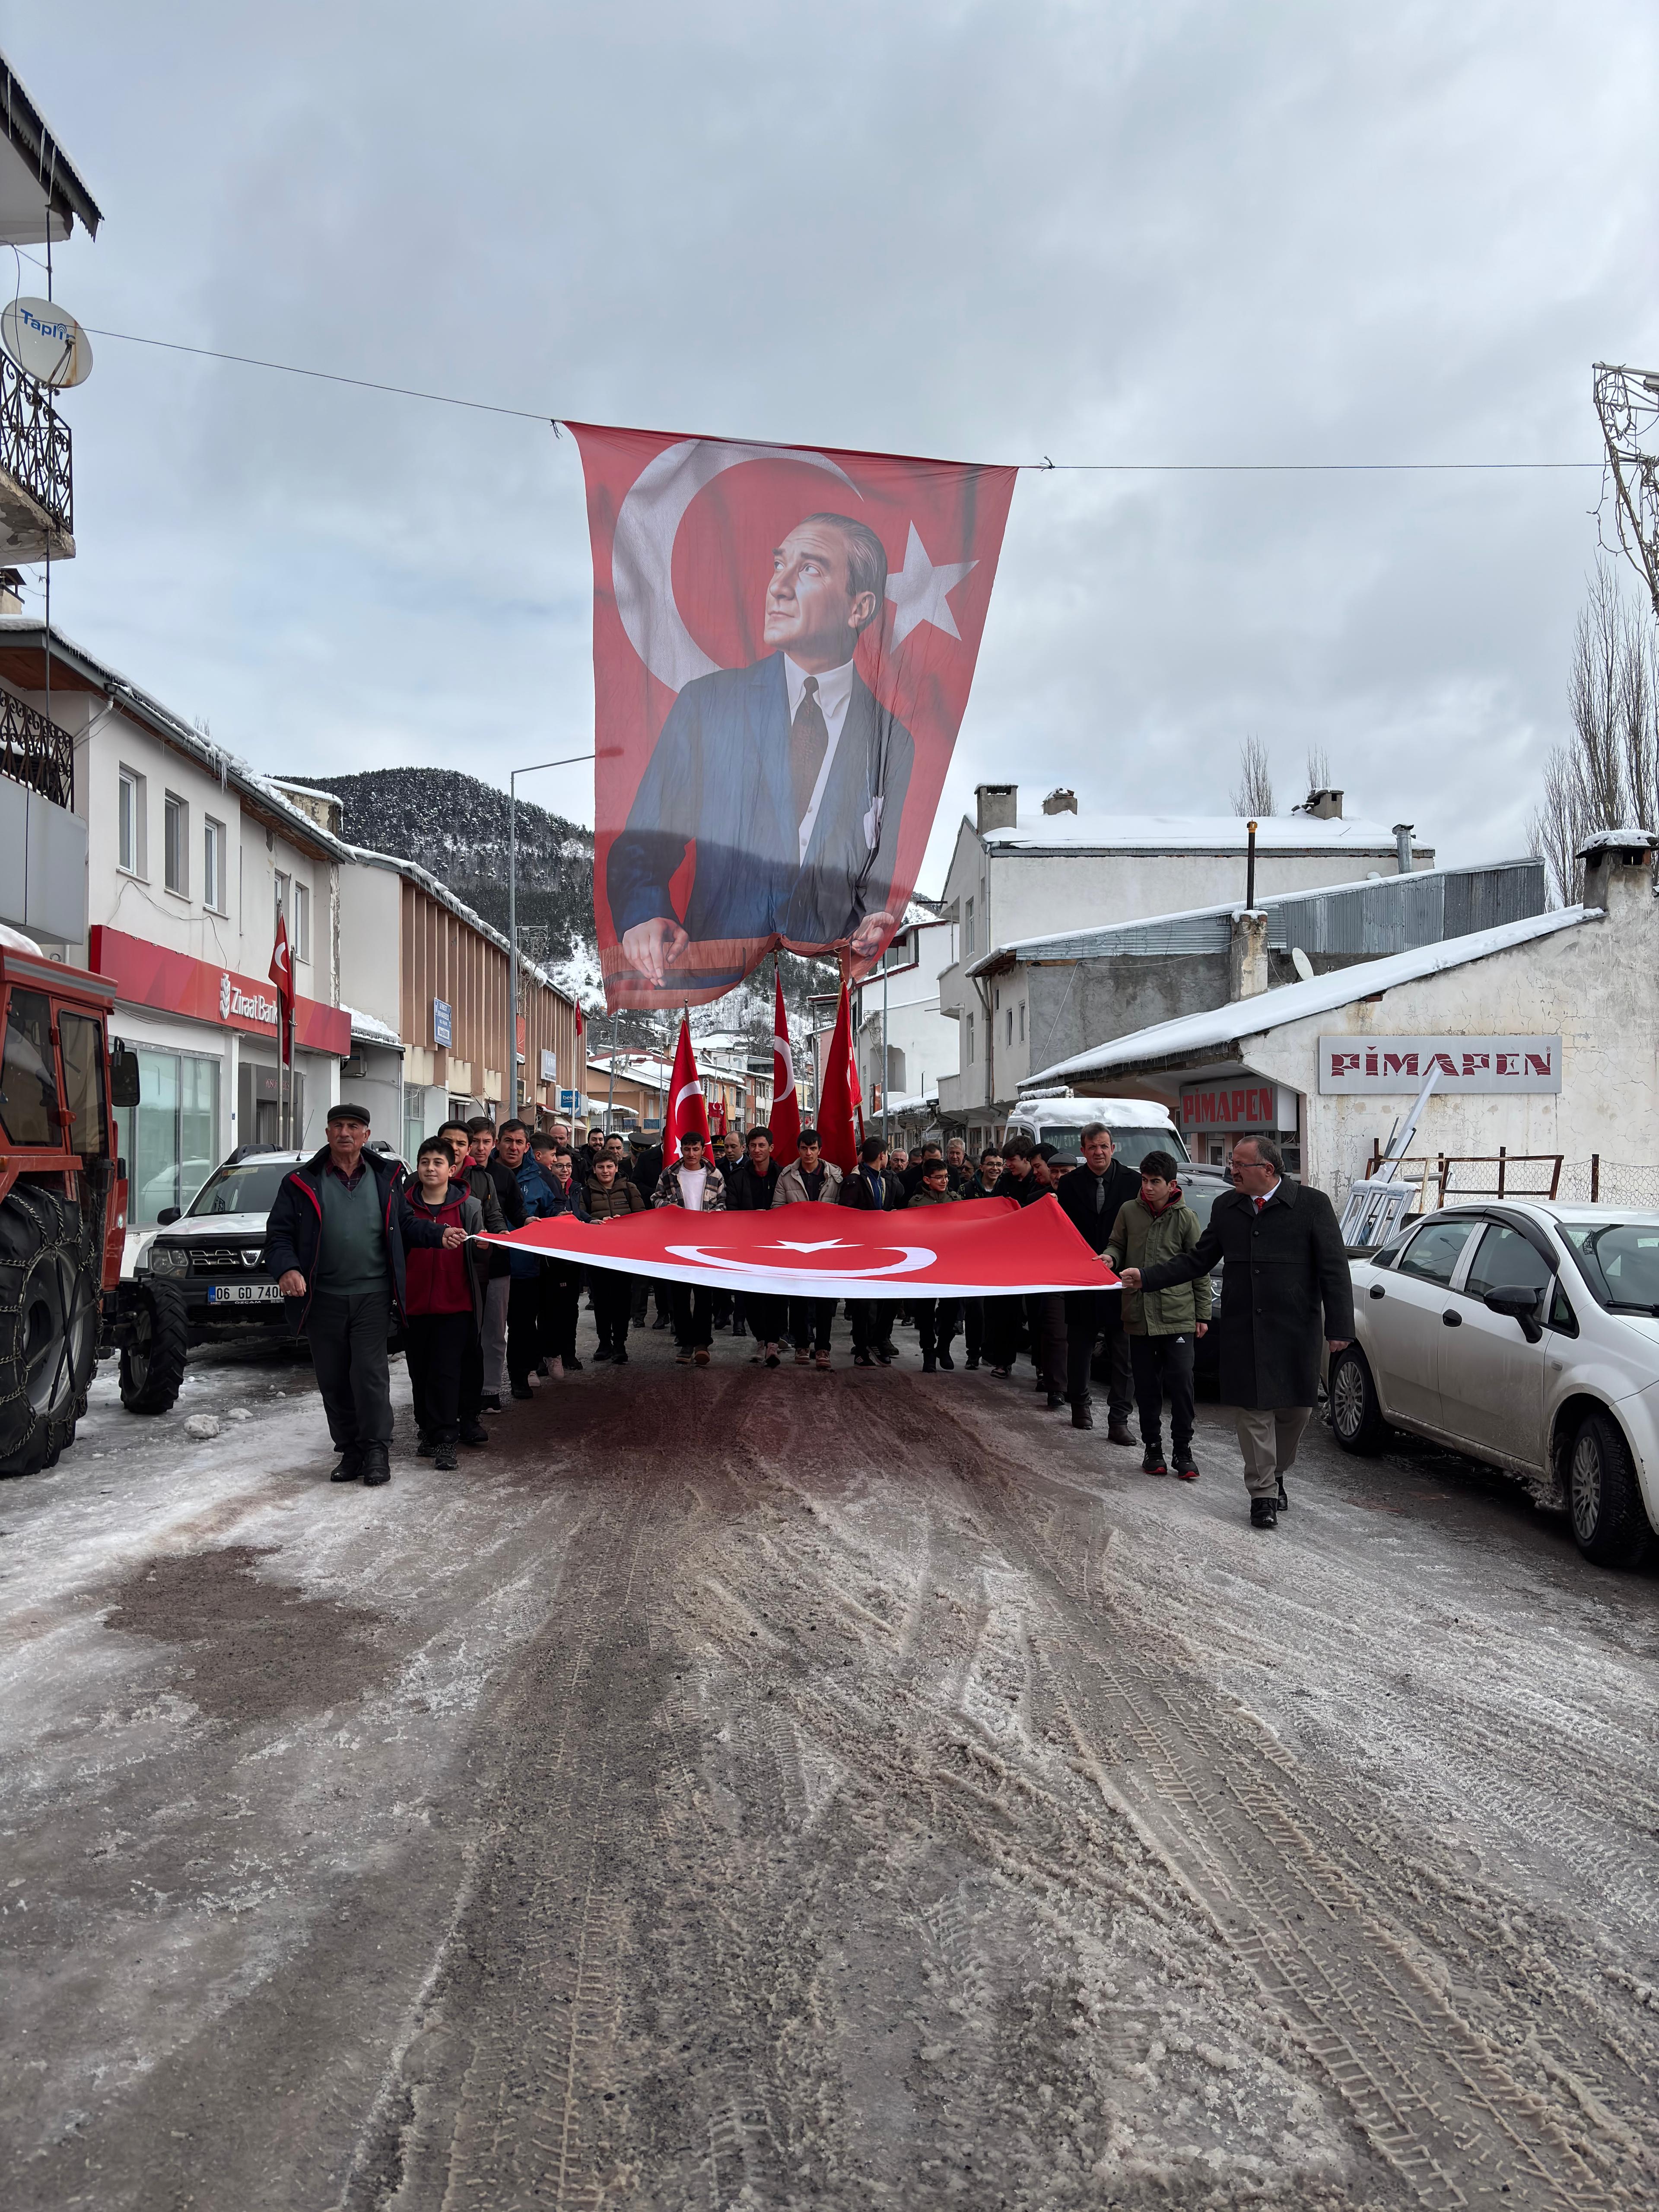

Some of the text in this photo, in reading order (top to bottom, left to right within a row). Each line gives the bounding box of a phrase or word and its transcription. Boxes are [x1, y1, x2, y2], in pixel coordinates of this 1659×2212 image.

[231, 987, 258, 1019] Ziraat
[1183, 1087, 1272, 1123] PİMAPEN
[216, 1287, 230, 1300] 06
[238, 1287, 251, 1299] GD
